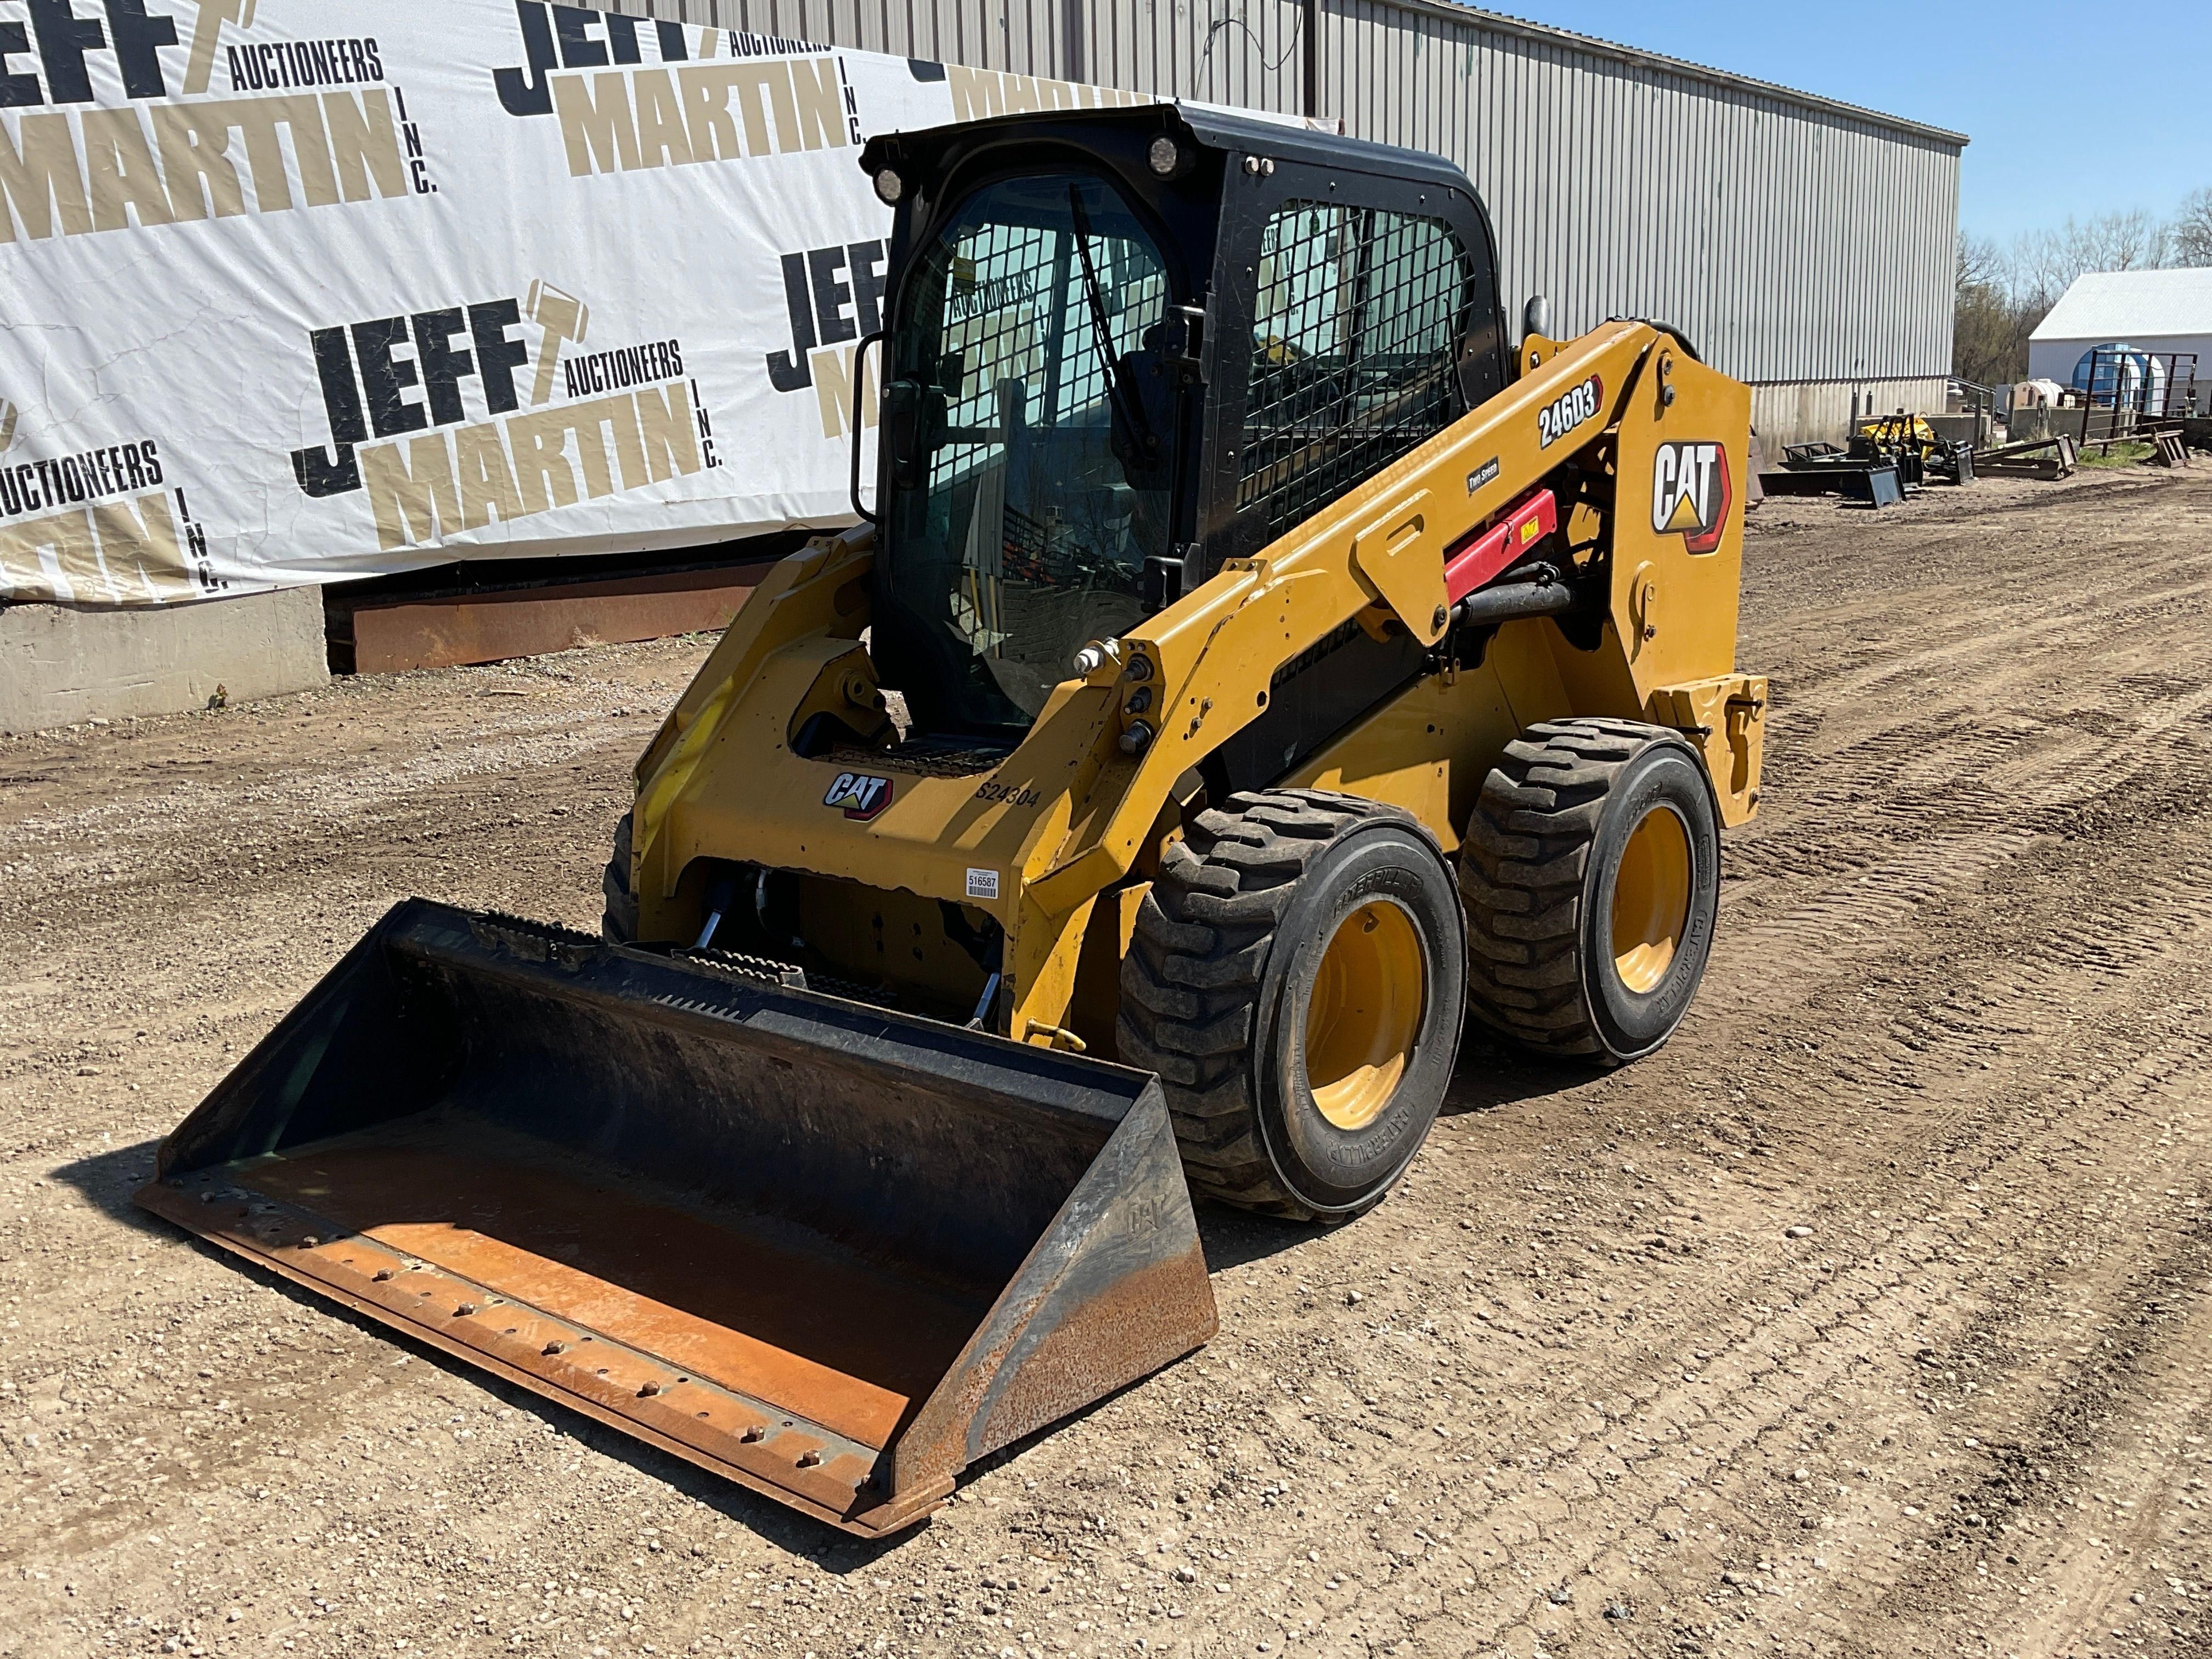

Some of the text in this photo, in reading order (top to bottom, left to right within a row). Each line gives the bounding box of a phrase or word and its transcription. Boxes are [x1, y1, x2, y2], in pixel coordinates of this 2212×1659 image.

[227, 38, 384, 91] AUCTIONEERS
[551, 58, 847, 177] MARTIN
[0, 89, 408, 243] MARTIN
[766, 238, 891, 392] JEF
[291, 297, 528, 497] JEFF
[564, 338, 683, 398] AUCTIONEERS
[1539, 380, 1595, 447] 246D3
[0, 440, 163, 517] UCTIONEERS
[360, 382, 701, 551] MARTIN
[1653, 444, 1716, 531] CAT
[826, 773, 886, 810] CAT
[975, 782, 1041, 807] S24304
[969, 876, 996, 887] 516587
